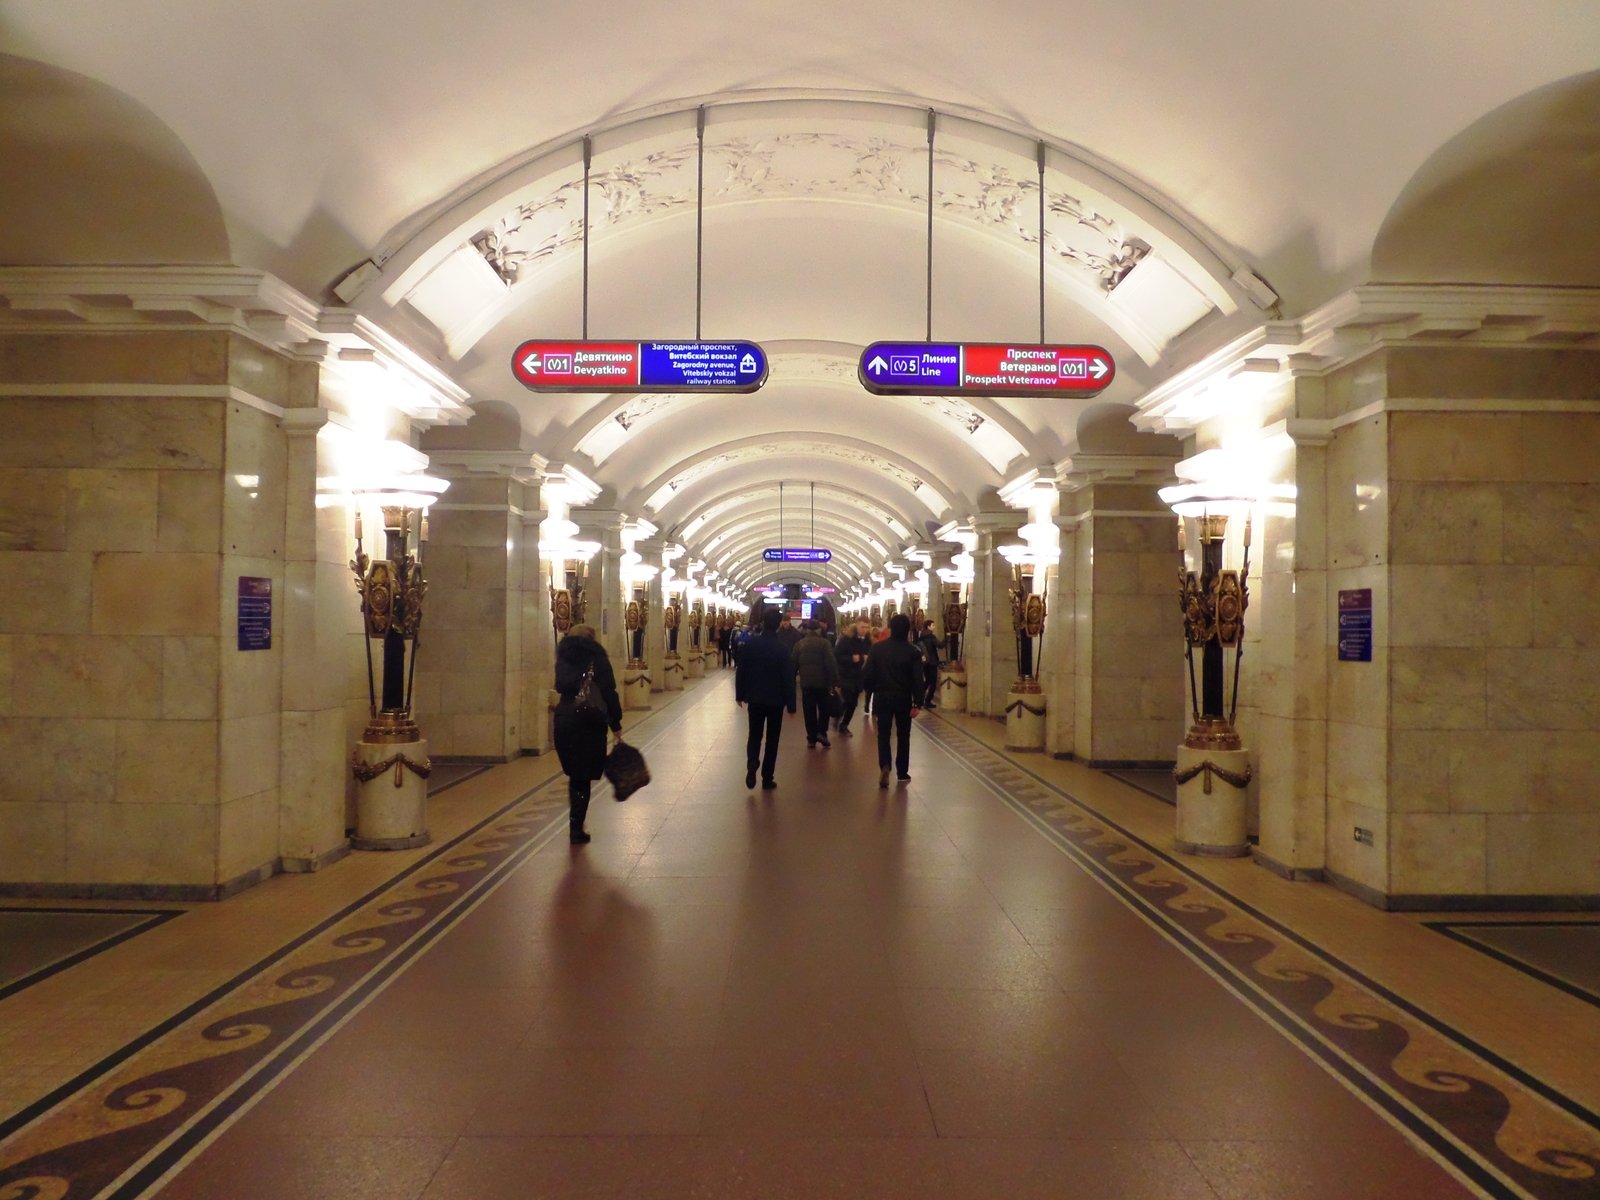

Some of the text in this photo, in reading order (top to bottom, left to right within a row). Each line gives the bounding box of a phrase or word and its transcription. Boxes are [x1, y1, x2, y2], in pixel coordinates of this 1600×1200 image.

[574, 352, 632, 362] Девяткино
[922, 354, 956, 363] Линия
[1007, 349, 1057, 360] Проспект
[574, 366, 627, 376] Devyatkino
[922, 367, 941, 376] Line
[1000, 362, 1056, 373] Ветеранов
[965, 375, 1057, 386] Prospekt Veteranov
